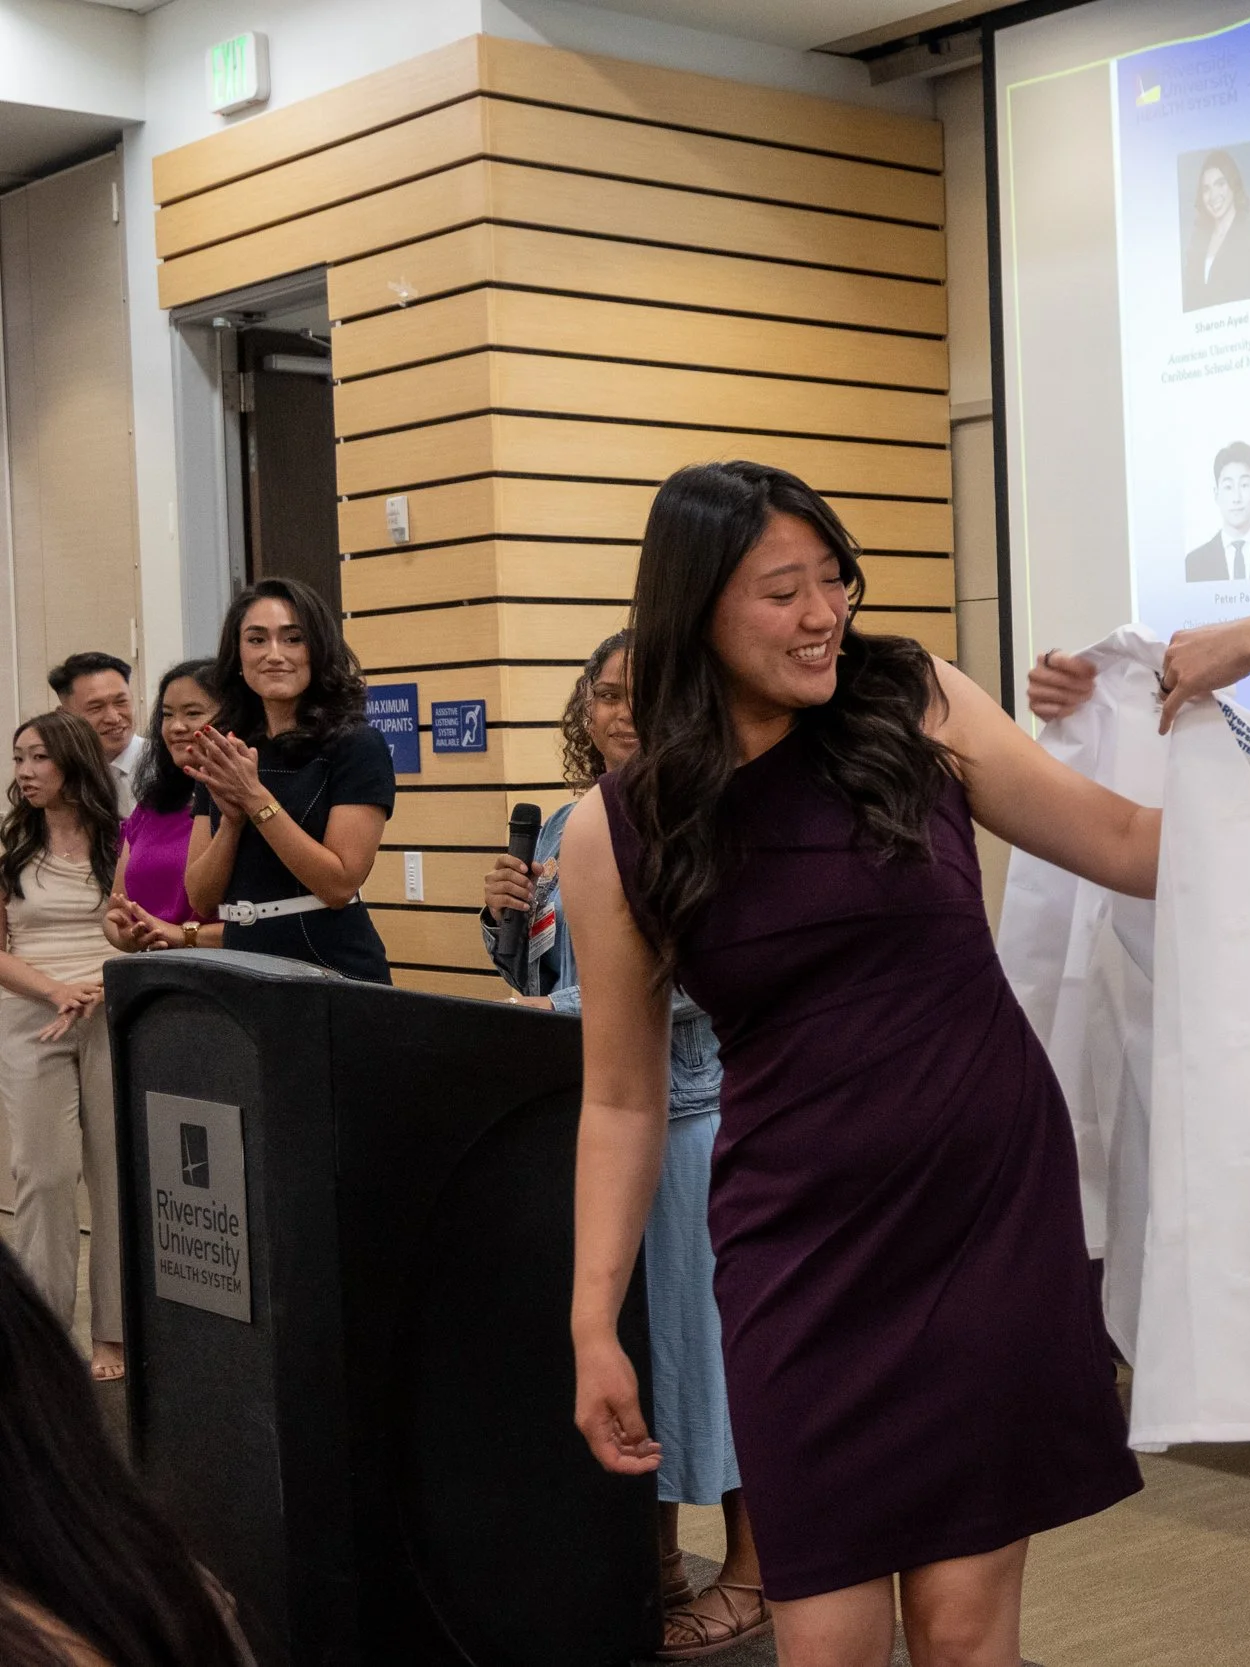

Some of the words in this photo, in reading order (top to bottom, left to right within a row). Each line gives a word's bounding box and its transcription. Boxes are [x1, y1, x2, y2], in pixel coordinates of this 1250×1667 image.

[211, 36, 248, 104] EXIT
[1194, 317, 1225, 334] Sharon
[1204, 360, 1234, 377] School
[1234, 356, 1245, 370] of
[1214, 593, 1238, 605] Peter
[366, 699, 409, 714] MAXIMUM
[435, 708, 458, 716] ASSISTIVE
[368, 718, 413, 732] CCUPANTS
[435, 718, 459, 727] LISTENING
[438, 728, 457, 737] SYSTEM
[436, 738, 460, 747] AVAILABLE
[156, 1189, 240, 1237] Riverside
[158, 1222, 240, 1276] University
[160, 1258, 200, 1284] HEALTH
[201, 1269, 242, 1295] SYSTEM
